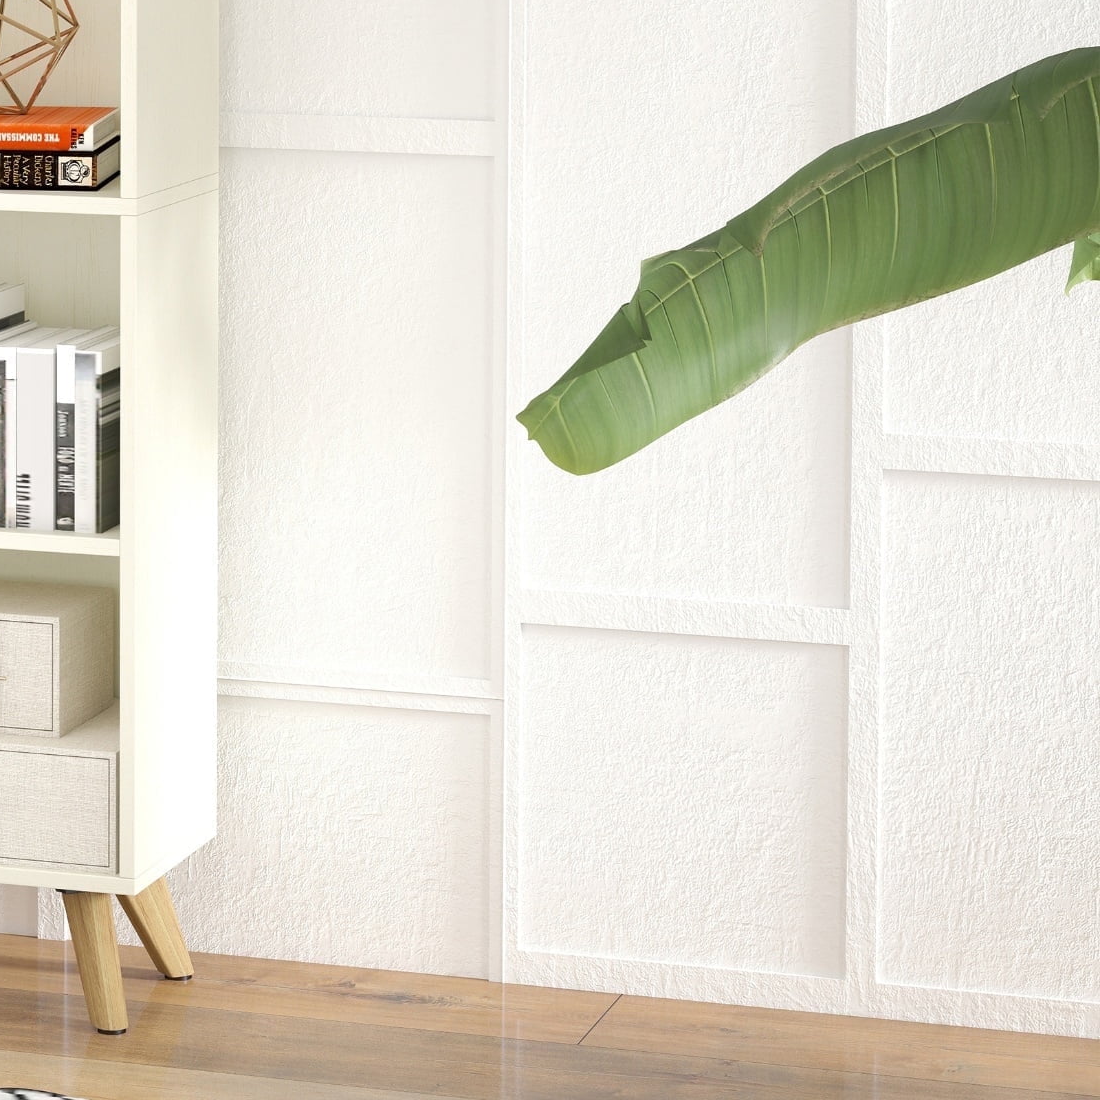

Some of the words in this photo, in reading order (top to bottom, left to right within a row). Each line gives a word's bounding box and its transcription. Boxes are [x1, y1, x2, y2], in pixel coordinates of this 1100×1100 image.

[44, 132, 60, 143] THE
[3, 154, 12, 187] History
[22, 156, 30, 165] A
[34, 154, 44, 187] Dickens
[44, 155, 54, 187] Charles
[20, 164, 31, 186] Very
